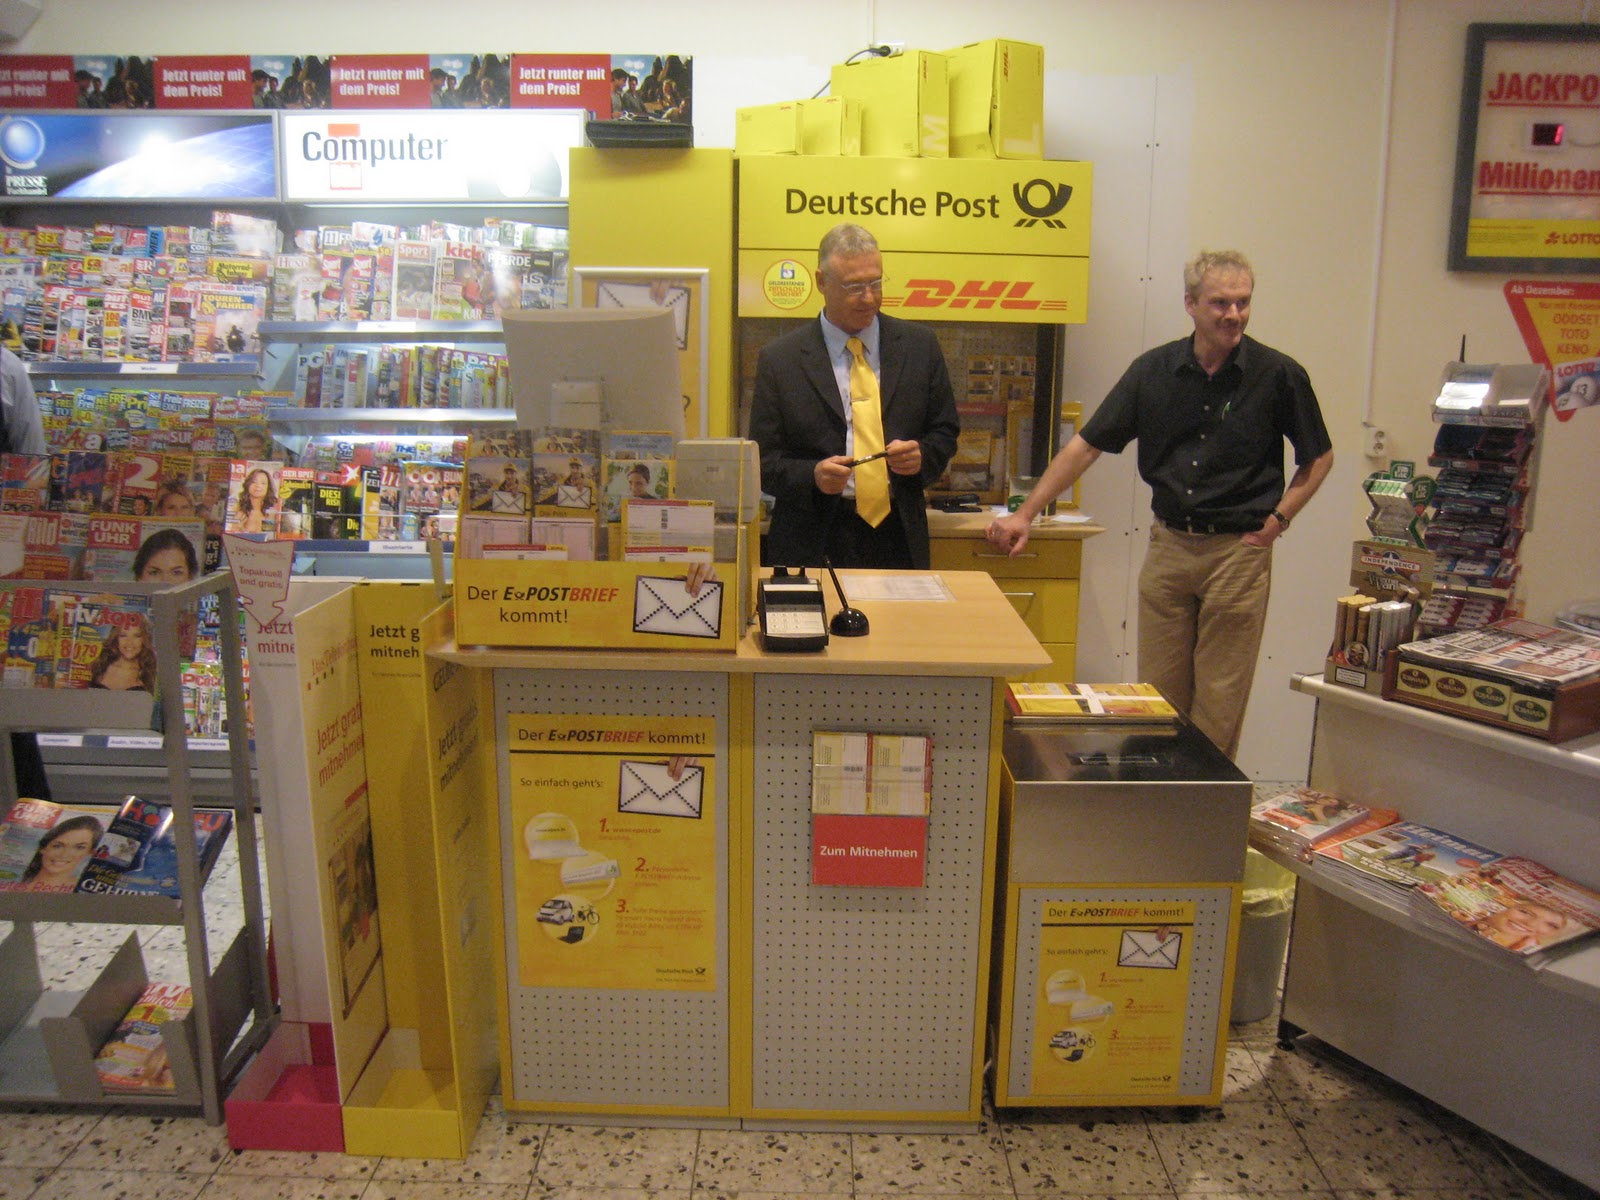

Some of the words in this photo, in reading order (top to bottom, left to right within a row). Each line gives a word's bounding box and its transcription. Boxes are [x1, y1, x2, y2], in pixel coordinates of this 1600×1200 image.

[163, 69, 188, 82] Jetzt
[190, 69, 225, 82] runter
[227, 69, 246, 82] mit
[339, 68, 365, 81] Jetzt
[368, 68, 403, 81] runter
[406, 68, 425, 81] mit
[519, 67, 545, 80] Jetzt
[548, 67, 584, 80] runter
[586, 67, 606, 80] mit
[163, 84, 189, 97] dem
[191, 84, 222, 97] Preis!
[339, 83, 364, 96] dem
[367, 83, 400, 96] Preis!
[519, 82, 545, 96] dem
[547, 82, 581, 96] Preis!
[1487, 72, 1600, 102] JACKPO
[302, 131, 448, 167] Computer
[786, 188, 926, 217] Deutsche
[936, 191, 1000, 219] Post
[902, 279, 1042, 310] DHL
[91, 520, 136, 533] FUNK
[94, 532, 130, 545] UHR
[1365, 557, 1416, 570] INDEPENDENCE
[238, 566, 283, 579] Topaktuell
[240, 577, 256, 587] und
[468, 586, 498, 602] Der
[499, 608, 569, 624] kommt!
[370, 625, 405, 640] Jetzt
[371, 645, 421, 658] mitneh
[518, 729, 543, 741] Der
[648, 731, 706, 745] kommt!
[520, 777, 532, 788] So
[534, 778, 570, 788] einfach
[572, 778, 604, 790] geht's:
[820, 846, 847, 857] Zum
[849, 847, 918, 858] Mitnehmen
[1049, 908, 1067, 917] Der
[1144, 908, 1185, 918] kommt!
